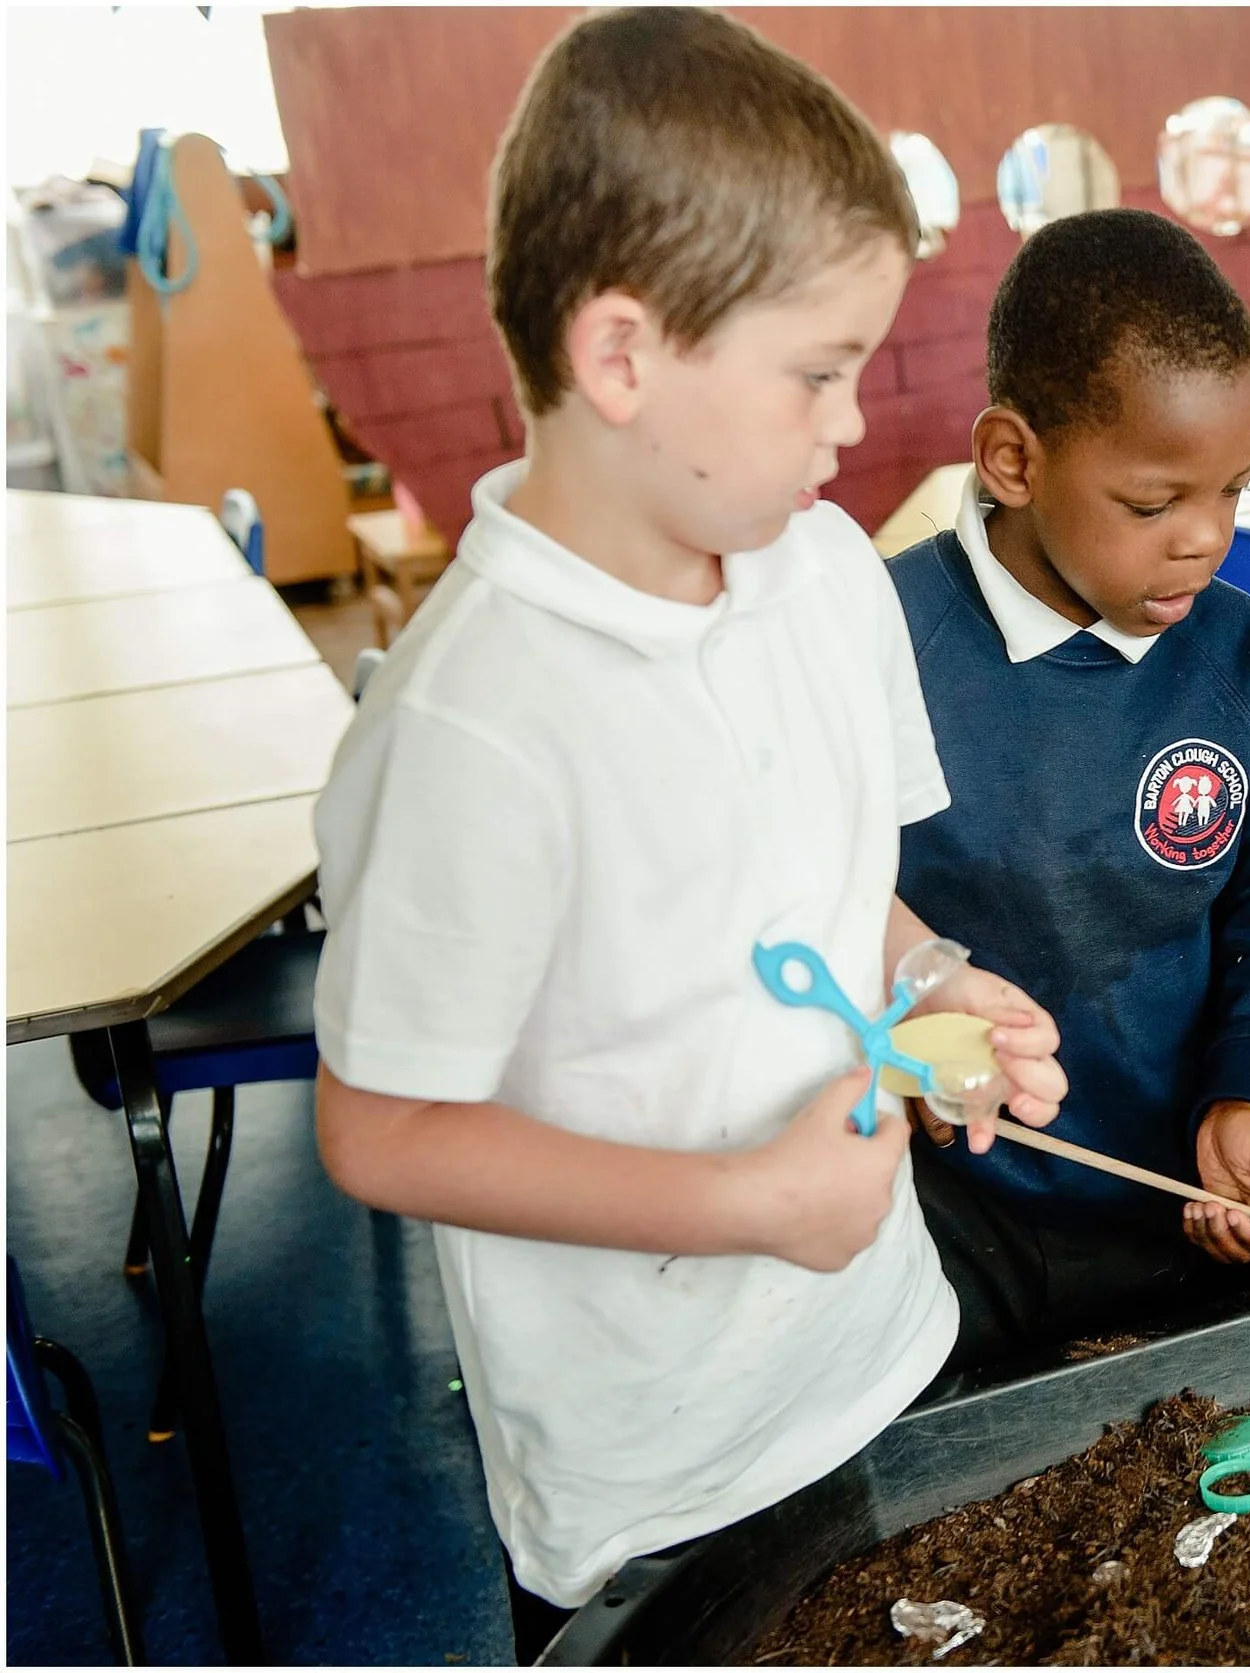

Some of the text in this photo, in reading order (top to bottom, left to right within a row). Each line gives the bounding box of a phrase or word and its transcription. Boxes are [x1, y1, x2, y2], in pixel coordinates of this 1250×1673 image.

[1144, 748, 1243, 810] BARTON CLOUGH SCHOOL
[1144, 819, 1235, 863] Working together
